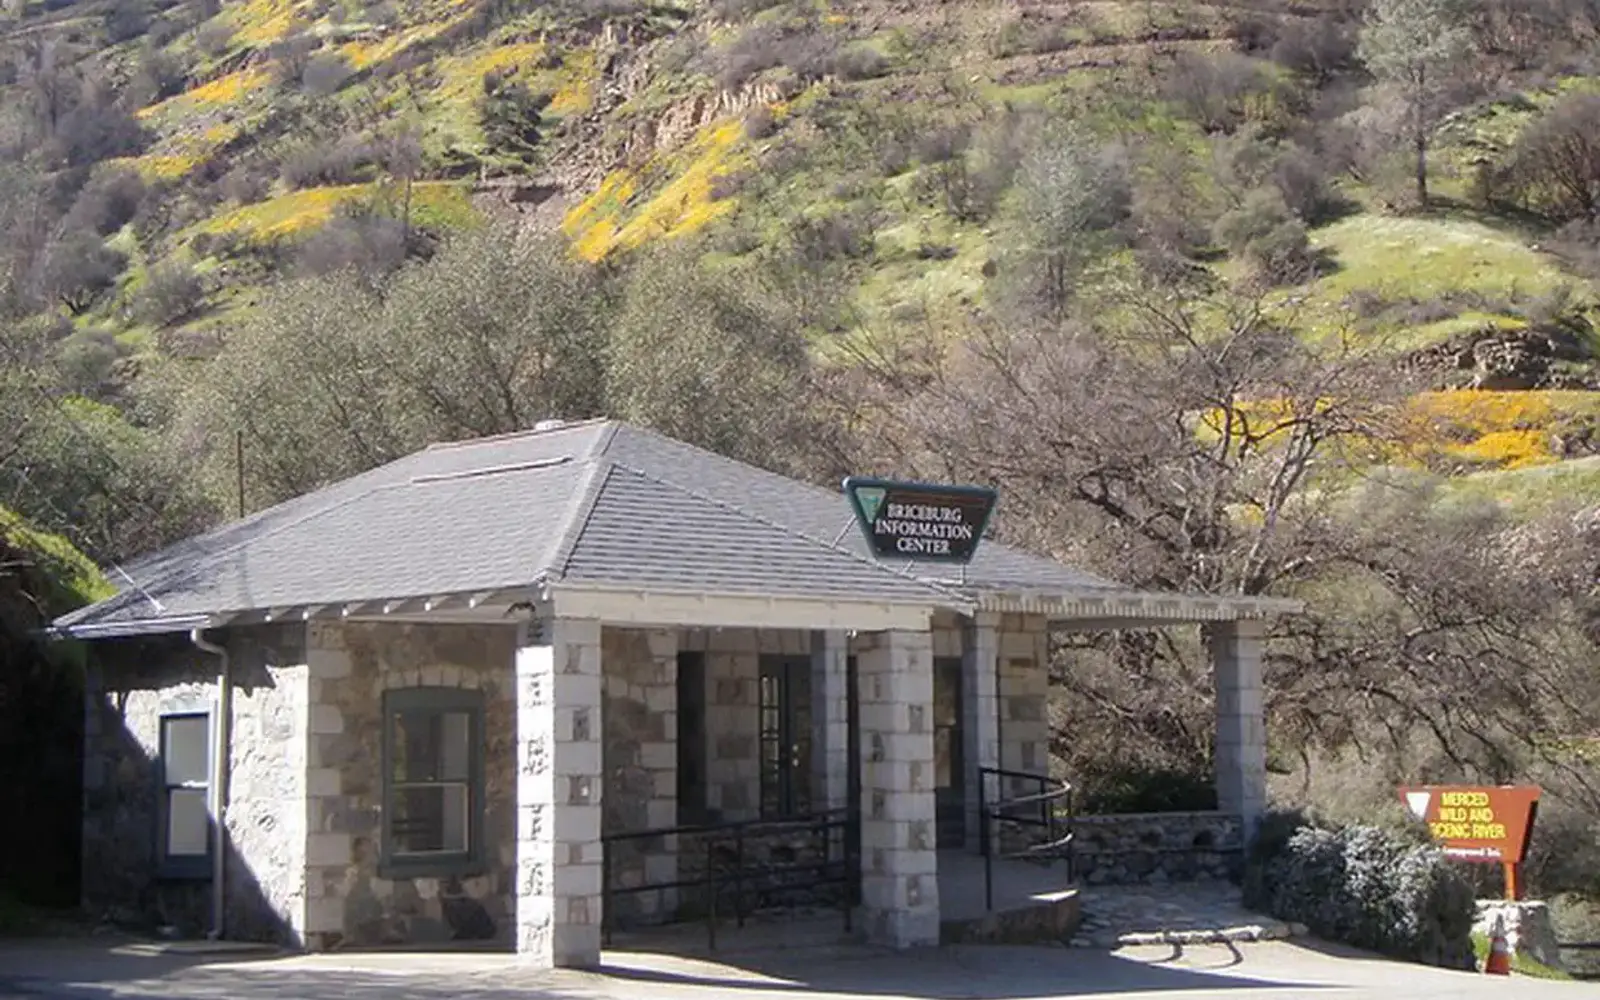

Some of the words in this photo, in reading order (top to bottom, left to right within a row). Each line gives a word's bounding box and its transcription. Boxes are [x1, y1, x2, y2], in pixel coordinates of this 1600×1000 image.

[887, 503, 962, 522] BRICEBURG
[874, 518, 973, 539] INFORMATION
[896, 537, 950, 553] CENTER
[1441, 792, 1489, 807] MERCED
[1439, 807, 1468, 822] WILD
[1469, 807, 1494, 823] AND
[1472, 822, 1505, 839] RIVER
